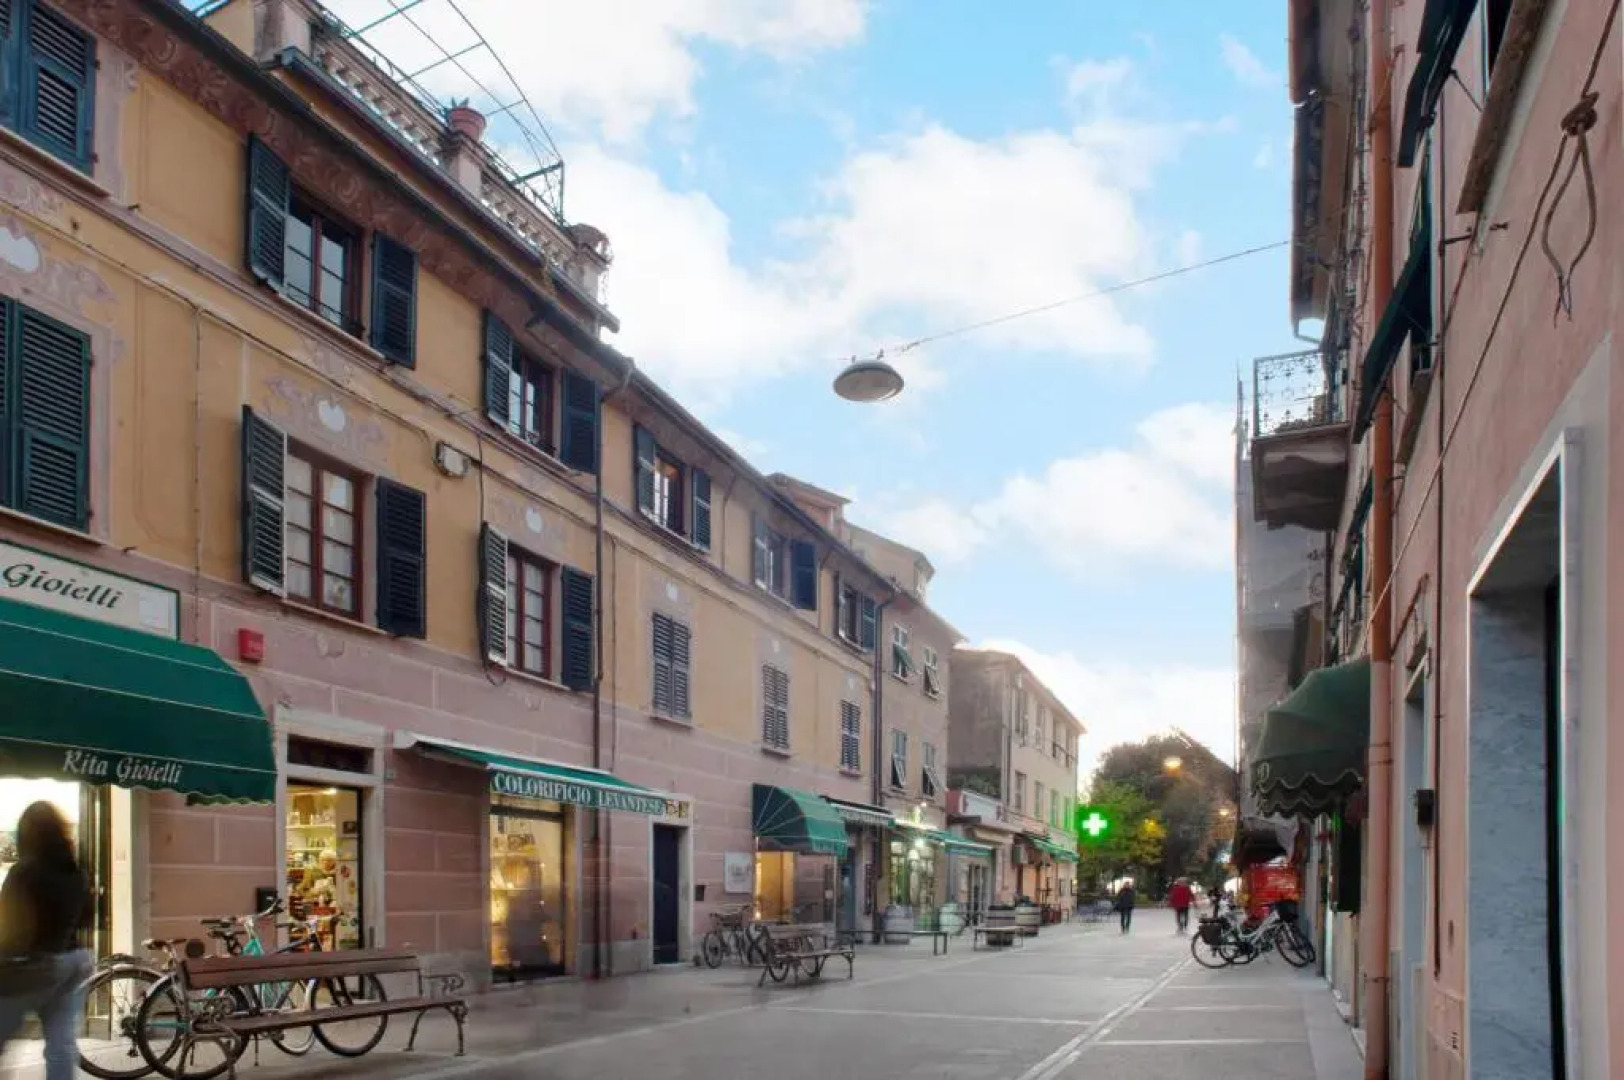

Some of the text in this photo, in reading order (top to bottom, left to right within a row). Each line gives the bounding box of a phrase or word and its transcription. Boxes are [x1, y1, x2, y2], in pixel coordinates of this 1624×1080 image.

[2, 563, 123, 609] Gioielli
[63, 750, 183, 783] Rita Gioielli
[494, 773, 590, 803] COLORIFICIO
[599, 790, 662, 814] LEVANTESE
